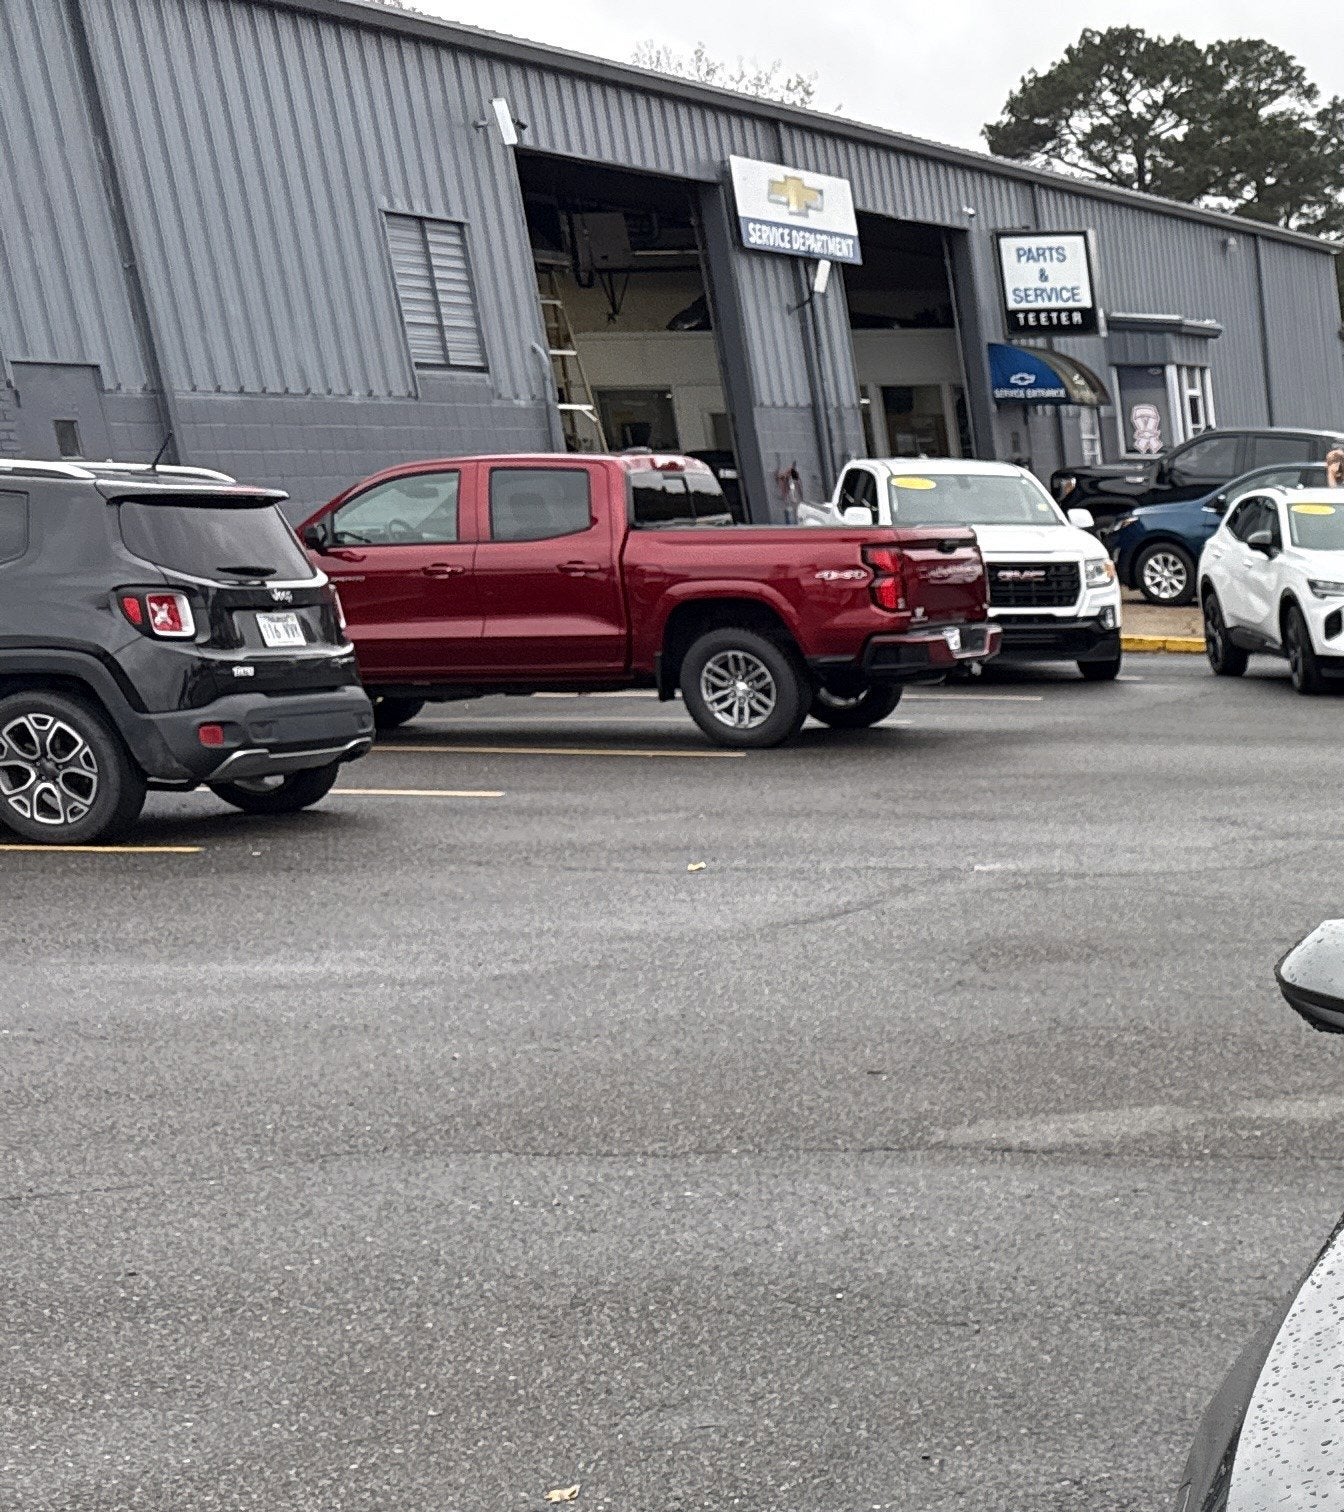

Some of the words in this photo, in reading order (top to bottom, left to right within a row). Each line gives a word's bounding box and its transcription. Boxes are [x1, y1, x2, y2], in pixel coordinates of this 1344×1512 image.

[748, 222, 790, 249] SERVICE
[792, 229, 854, 258] DEPARTMENT
[1016, 246, 1067, 263] PARTS
[1038, 266, 1049, 283] &
[1011, 286, 1083, 304] SERVICE
[1016, 311, 1083, 326] TEETER
[997, 570, 1046, 581] GMC
